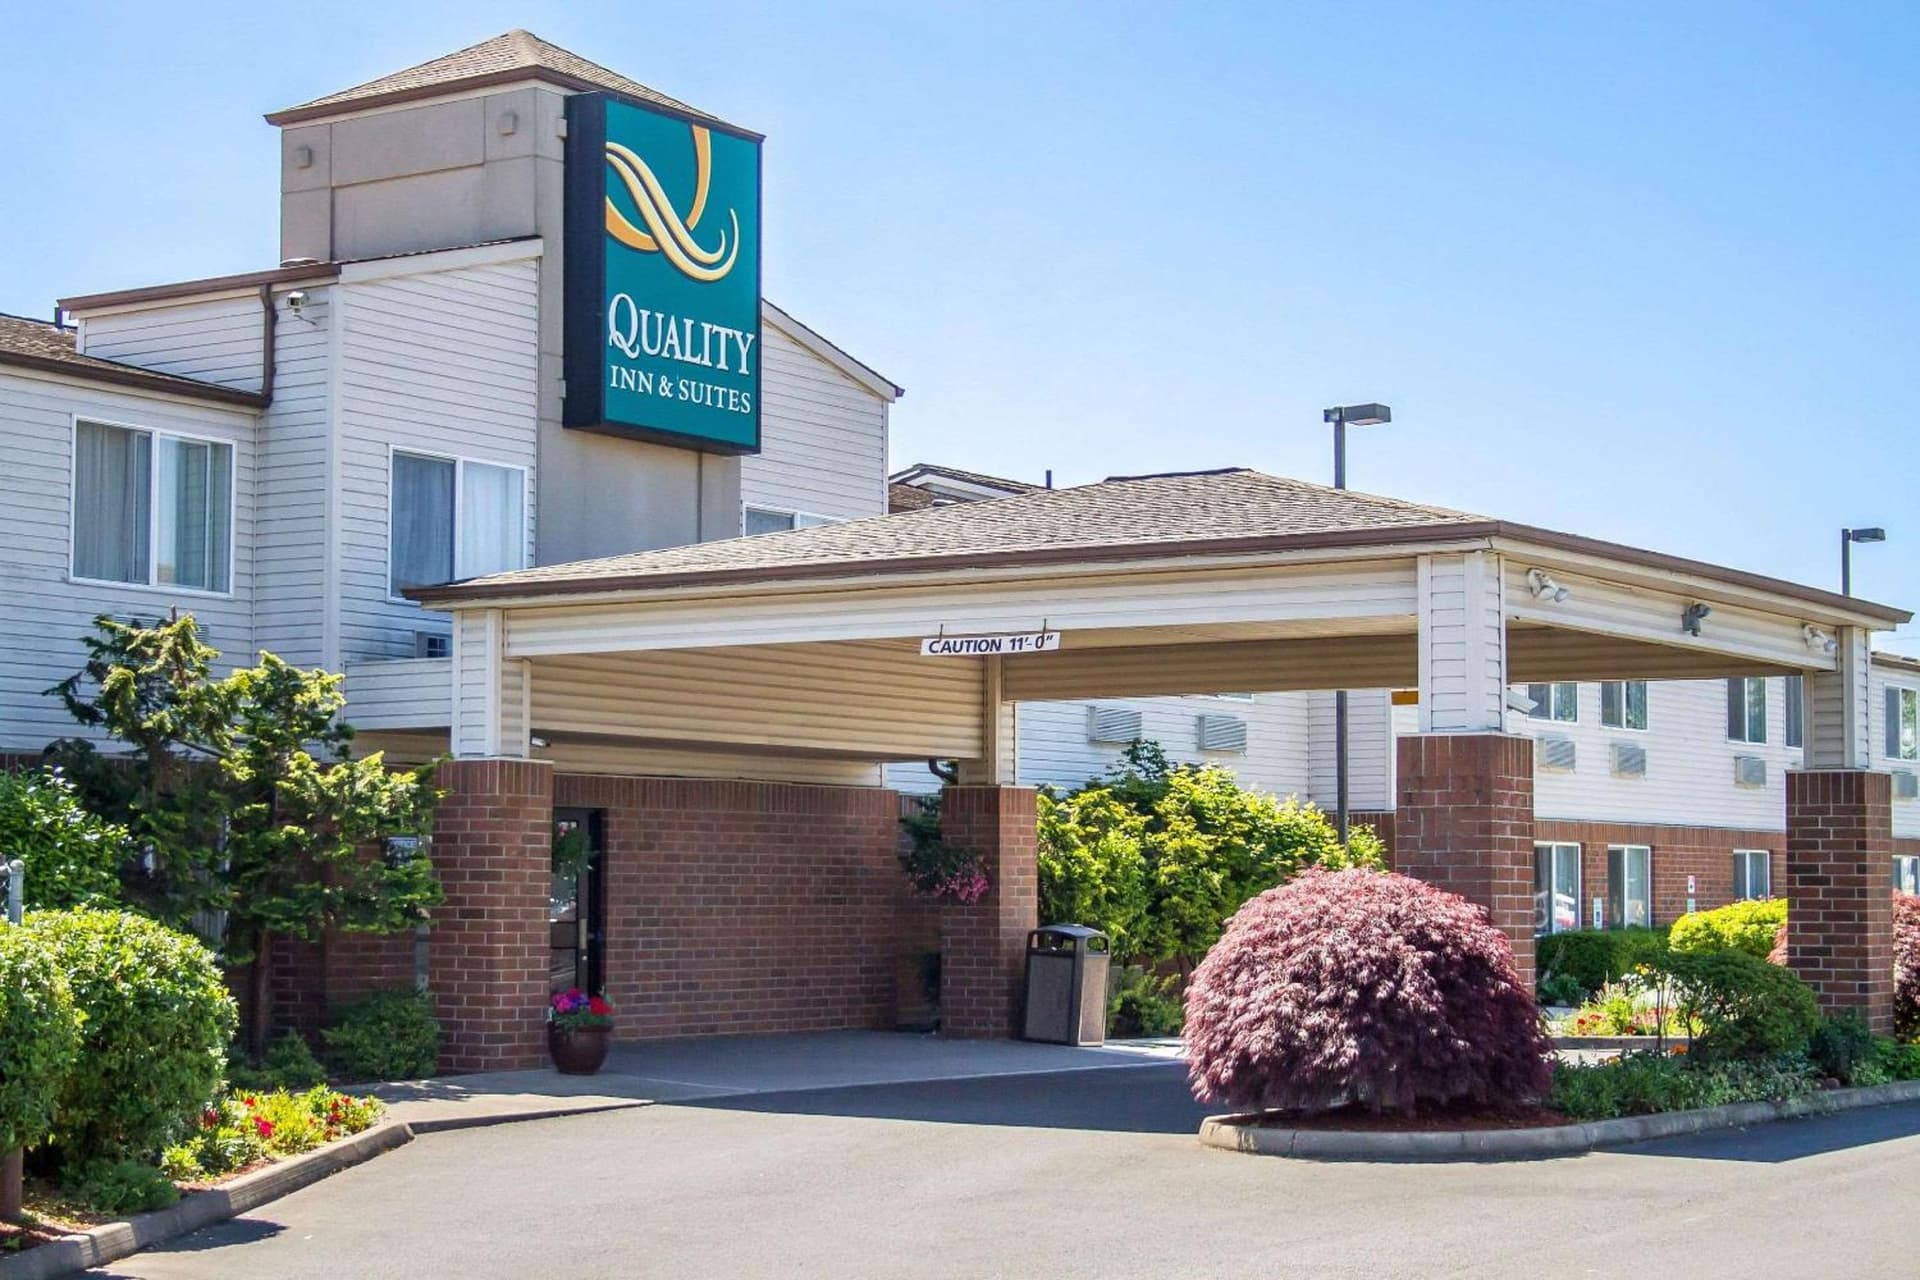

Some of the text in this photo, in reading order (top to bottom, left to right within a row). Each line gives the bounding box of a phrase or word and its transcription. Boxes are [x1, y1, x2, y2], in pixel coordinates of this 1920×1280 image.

[608, 292, 754, 375] QUALITY
[610, 365, 751, 414] INN & SUITES
[928, 638, 1002, 654] CAUTION
